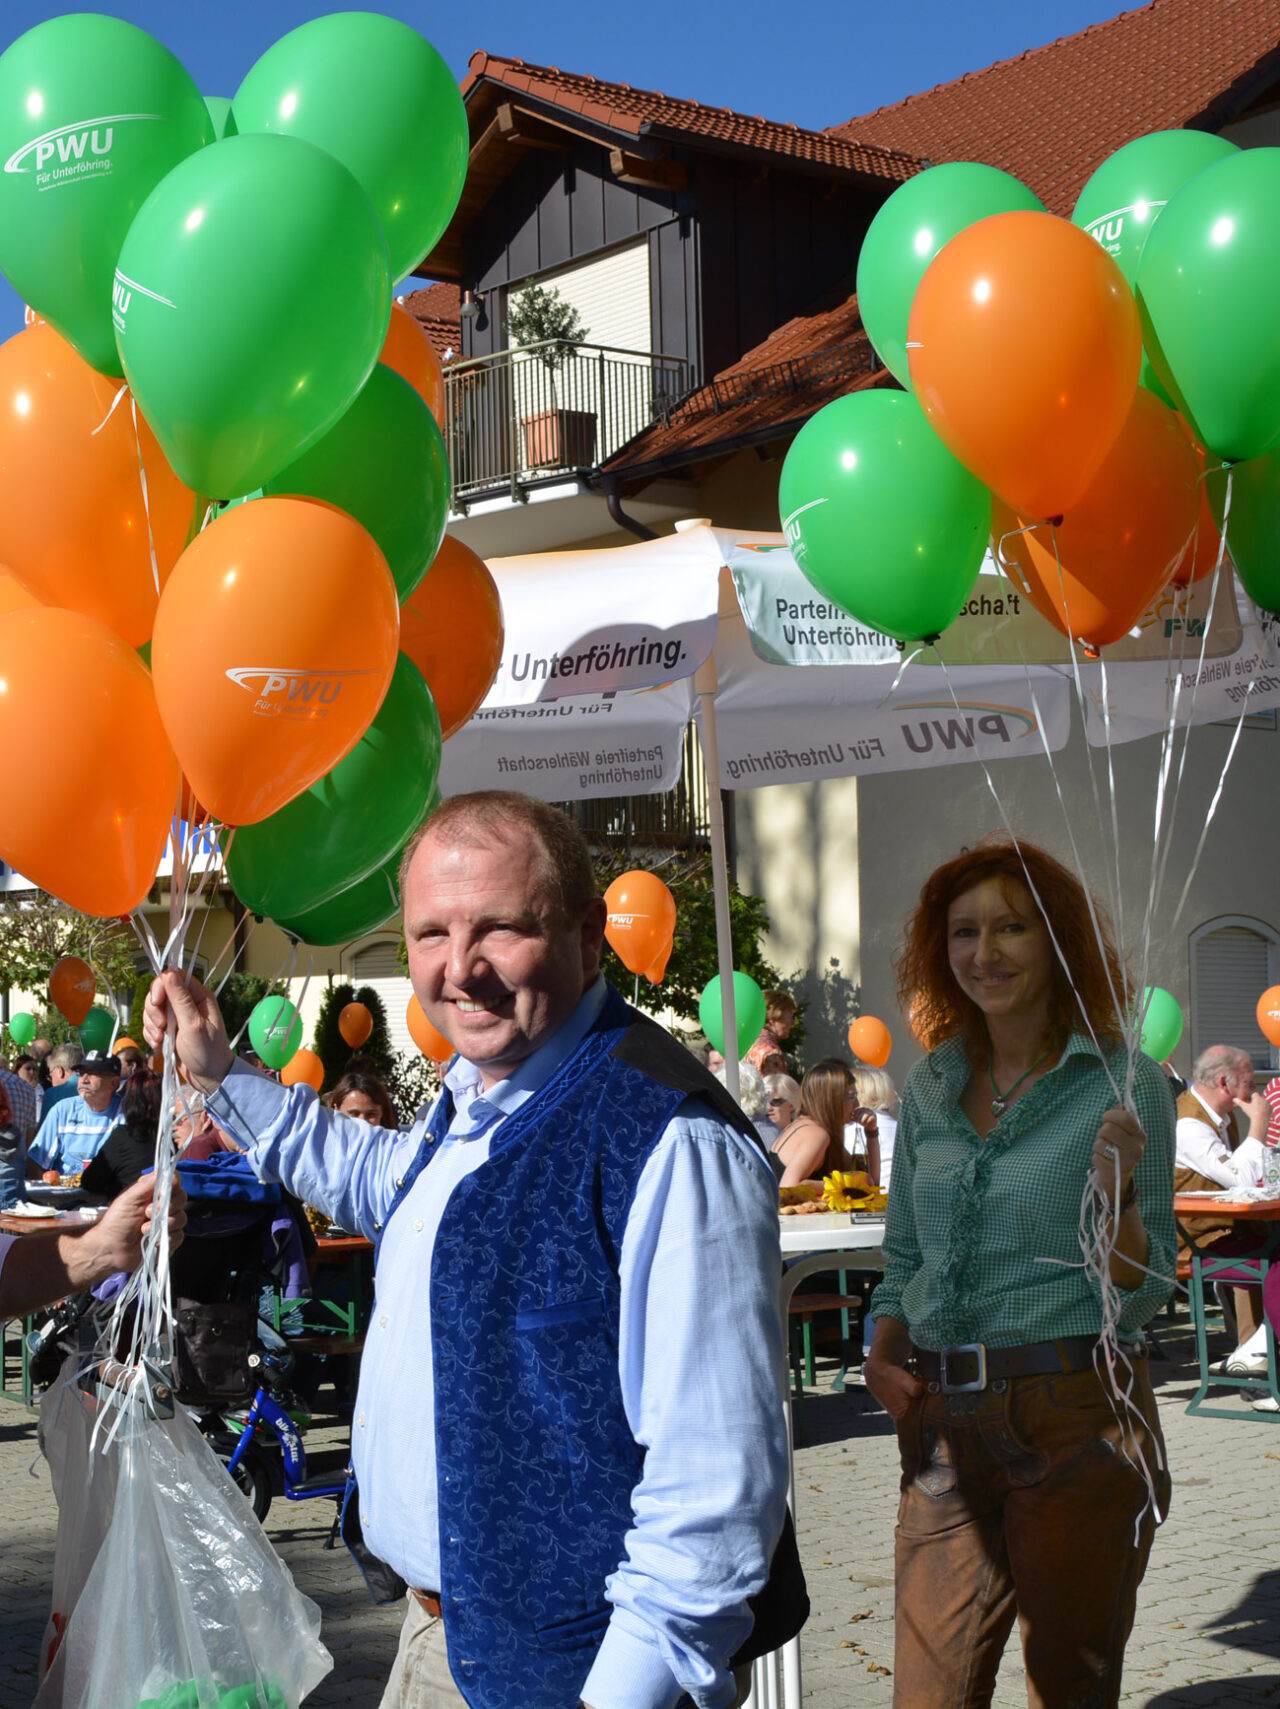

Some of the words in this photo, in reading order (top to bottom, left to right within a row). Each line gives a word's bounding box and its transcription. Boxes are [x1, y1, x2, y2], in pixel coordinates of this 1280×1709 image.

[36, 128, 113, 170] PWU
[36, 172, 51, 185] Für
[52, 159, 113, 180] Unterföhring.
[511, 637, 687, 682] Unterföhring.
[261, 676, 343, 703] PWU
[254, 699, 271, 711] Für
